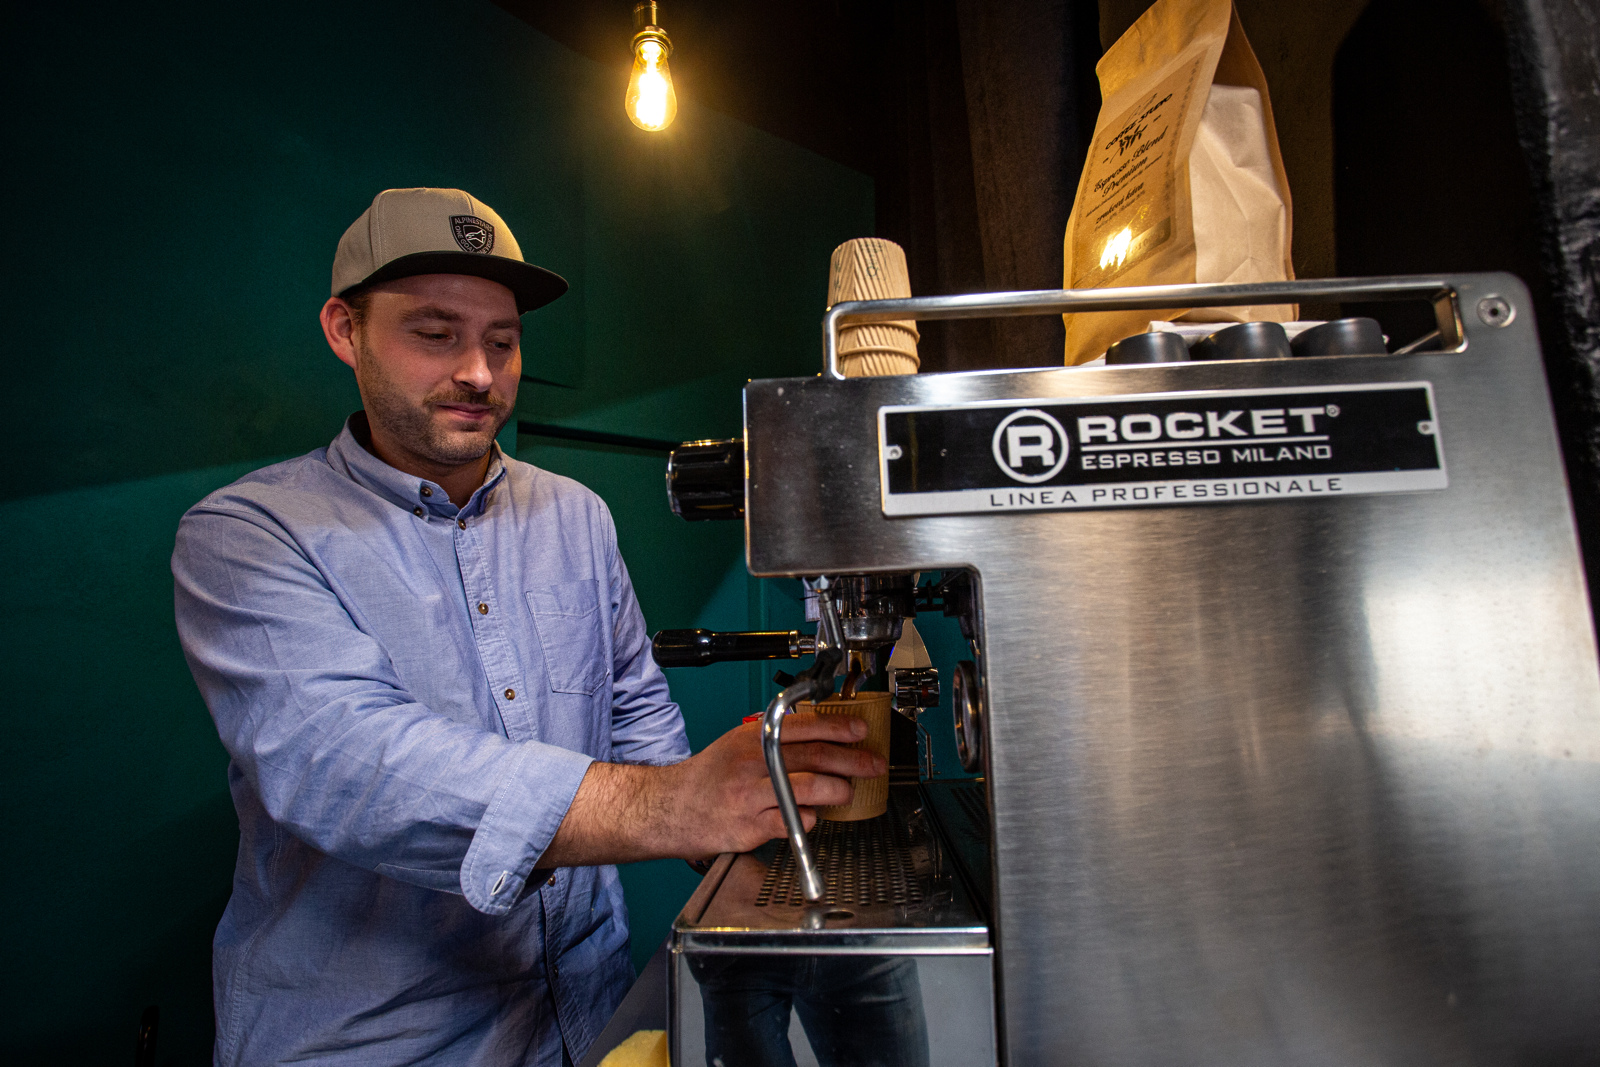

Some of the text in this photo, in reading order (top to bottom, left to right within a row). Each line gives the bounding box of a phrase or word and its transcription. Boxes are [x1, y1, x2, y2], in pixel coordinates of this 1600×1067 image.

[1131, 125, 1168, 161] Blend
[1102, 156, 1148, 197] Premium
[454, 216, 493, 232] ALPINESTARS
[1080, 444, 1332, 470] ESPRESSO MILANO
[990, 477, 1344, 508] LINEA PROFESSIONALE
